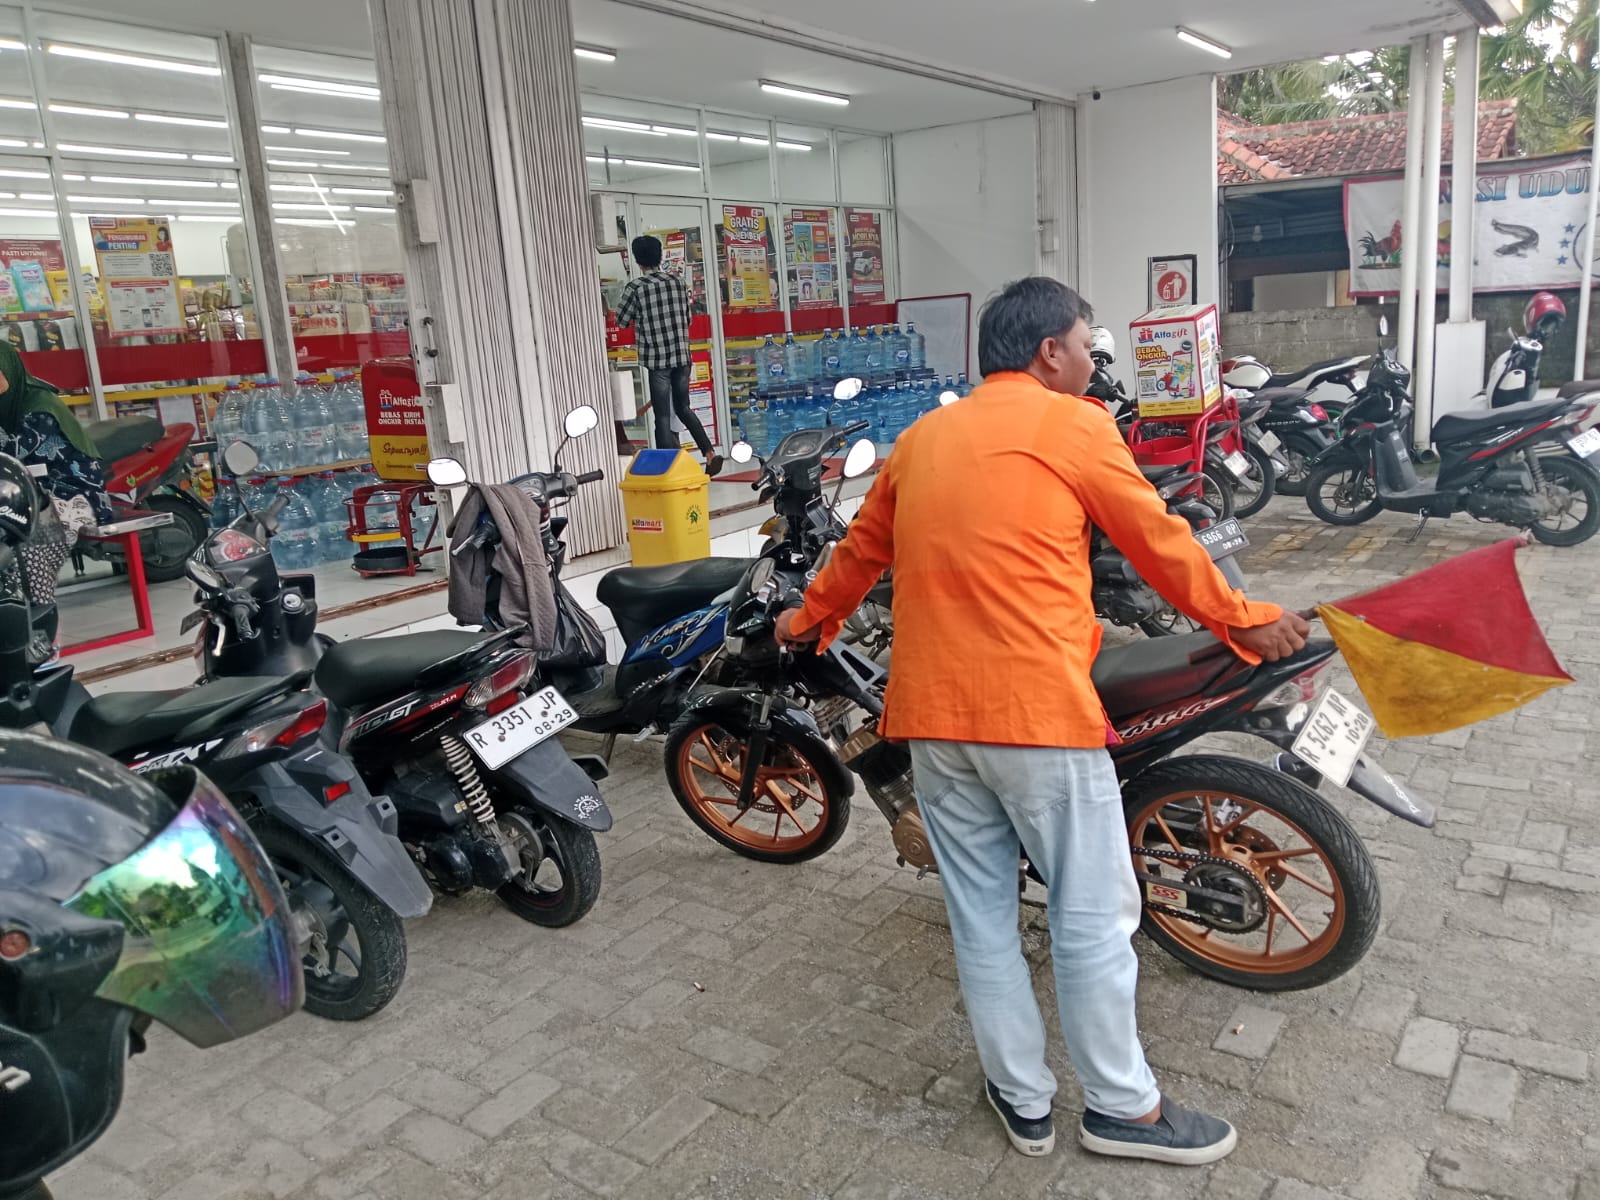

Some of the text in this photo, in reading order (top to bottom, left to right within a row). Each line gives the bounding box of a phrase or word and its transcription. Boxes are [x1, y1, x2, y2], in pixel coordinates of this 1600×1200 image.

[1438, 167, 1591, 204] NSI UDU
[730, 216, 759, 230] GRATIS
[108, 242, 137, 250] PENTING
[1136, 345, 1162, 354] BEBAS
[1136, 352, 1168, 360] ONGKIR
[471, 691, 556, 749] R 3351 JP
[1296, 693, 1348, 764] R 5462 AP
